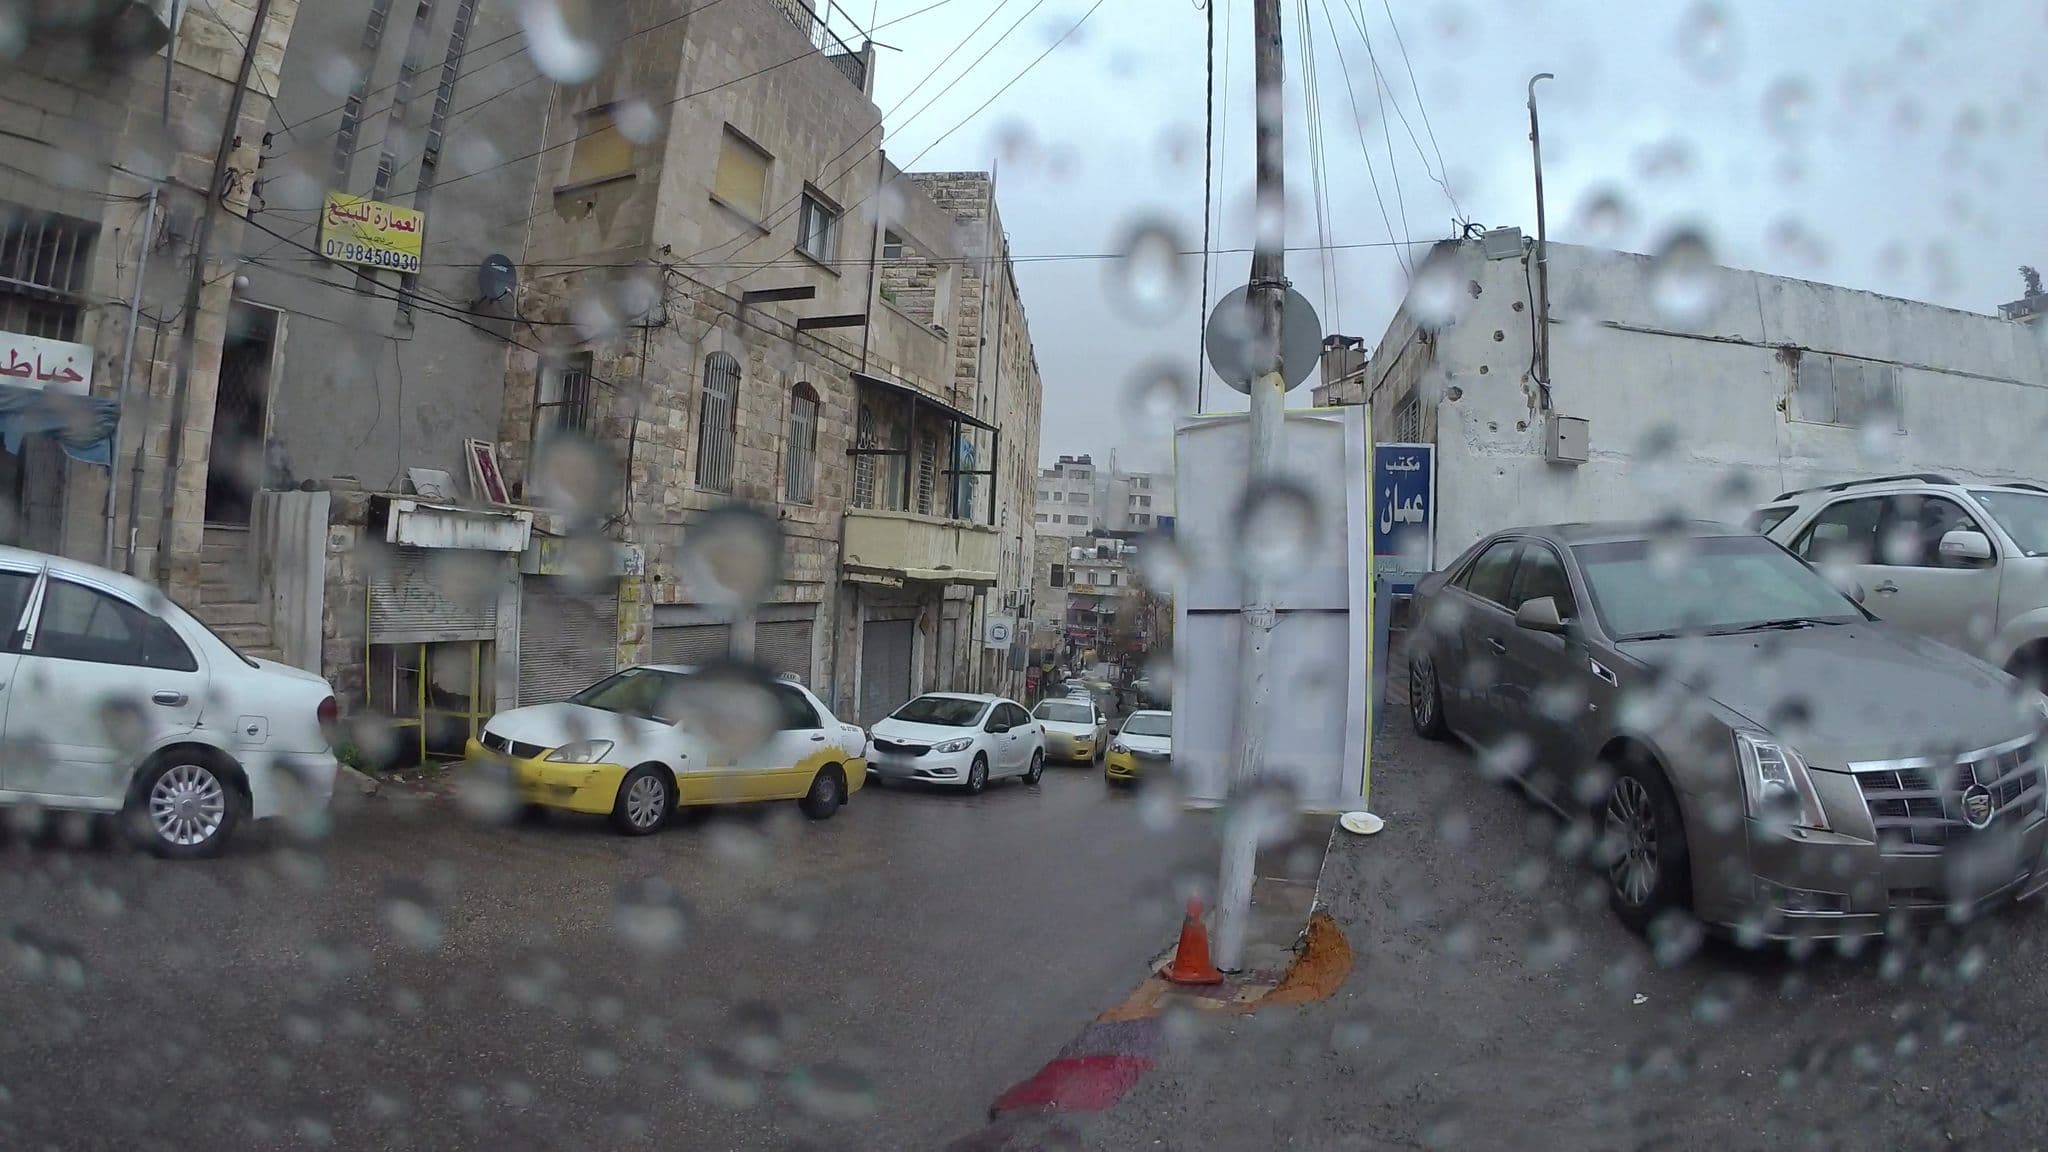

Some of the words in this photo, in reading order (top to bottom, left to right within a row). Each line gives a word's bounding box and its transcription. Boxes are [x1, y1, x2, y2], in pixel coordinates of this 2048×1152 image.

[328, 202, 371, 228] للبيع
[374, 206, 421, 232] العمارة
[326, 239, 418, 271] 0798450930
[0, 347, 84, 382] خياط
[1385, 456, 1421, 475] مكتب
[1380, 482, 1425, 535] عمان
